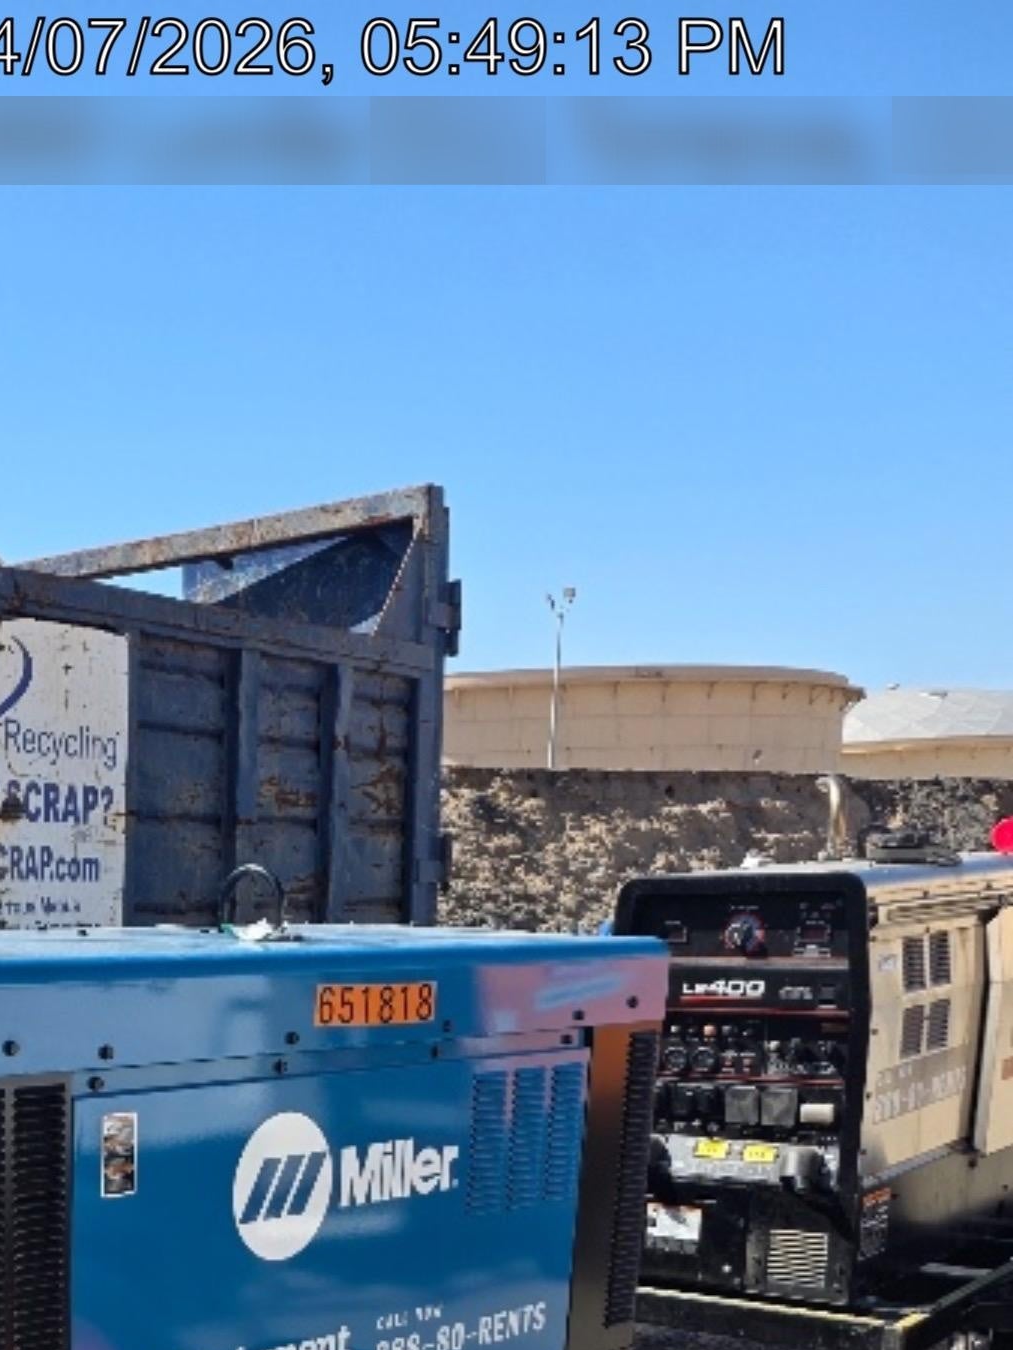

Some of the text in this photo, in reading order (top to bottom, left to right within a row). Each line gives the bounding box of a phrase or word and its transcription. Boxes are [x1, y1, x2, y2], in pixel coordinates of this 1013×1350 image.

[3, 718, 119, 770] Recycling
[319, 983, 432, 1024] 651818
[340, 1137, 459, 1208] Miller
